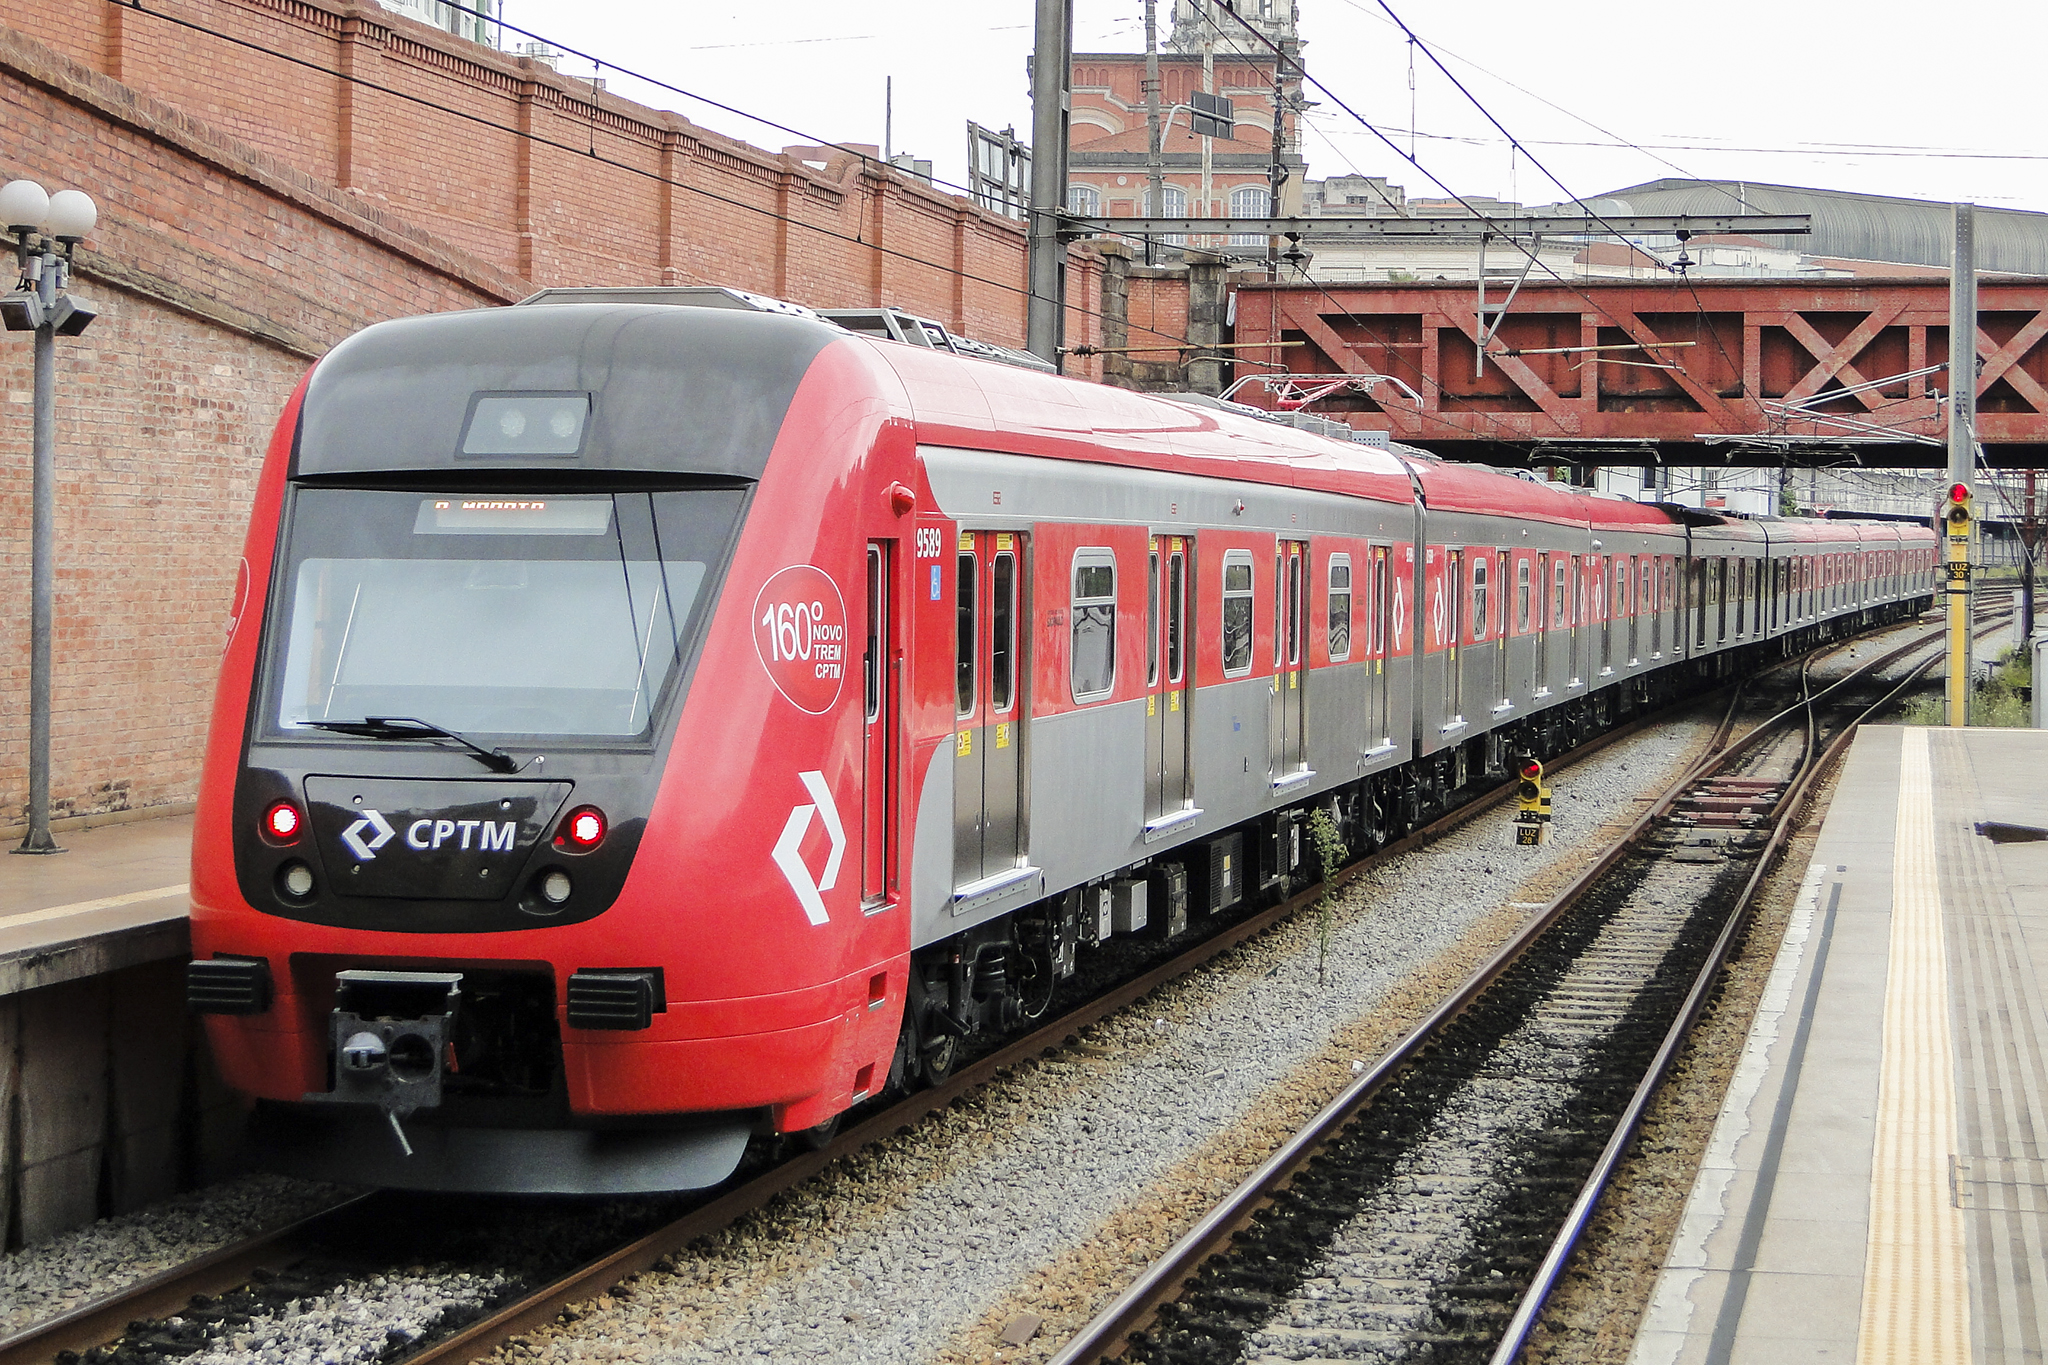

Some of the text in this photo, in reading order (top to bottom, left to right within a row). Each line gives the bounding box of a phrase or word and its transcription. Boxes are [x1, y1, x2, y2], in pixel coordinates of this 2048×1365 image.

[916, 527, 942, 558] 9589
[1950, 563, 1968, 571] LUZ
[1953, 571, 1965, 579] 30
[812, 624, 843, 641] NOVO
[813, 644, 842, 661] TREM
[815, 663, 841, 679] CPTM
[406, 818, 517, 851] CPTM
[1519, 828, 1537, 837] LUZ
[1522, 836, 1533, 844] 28
